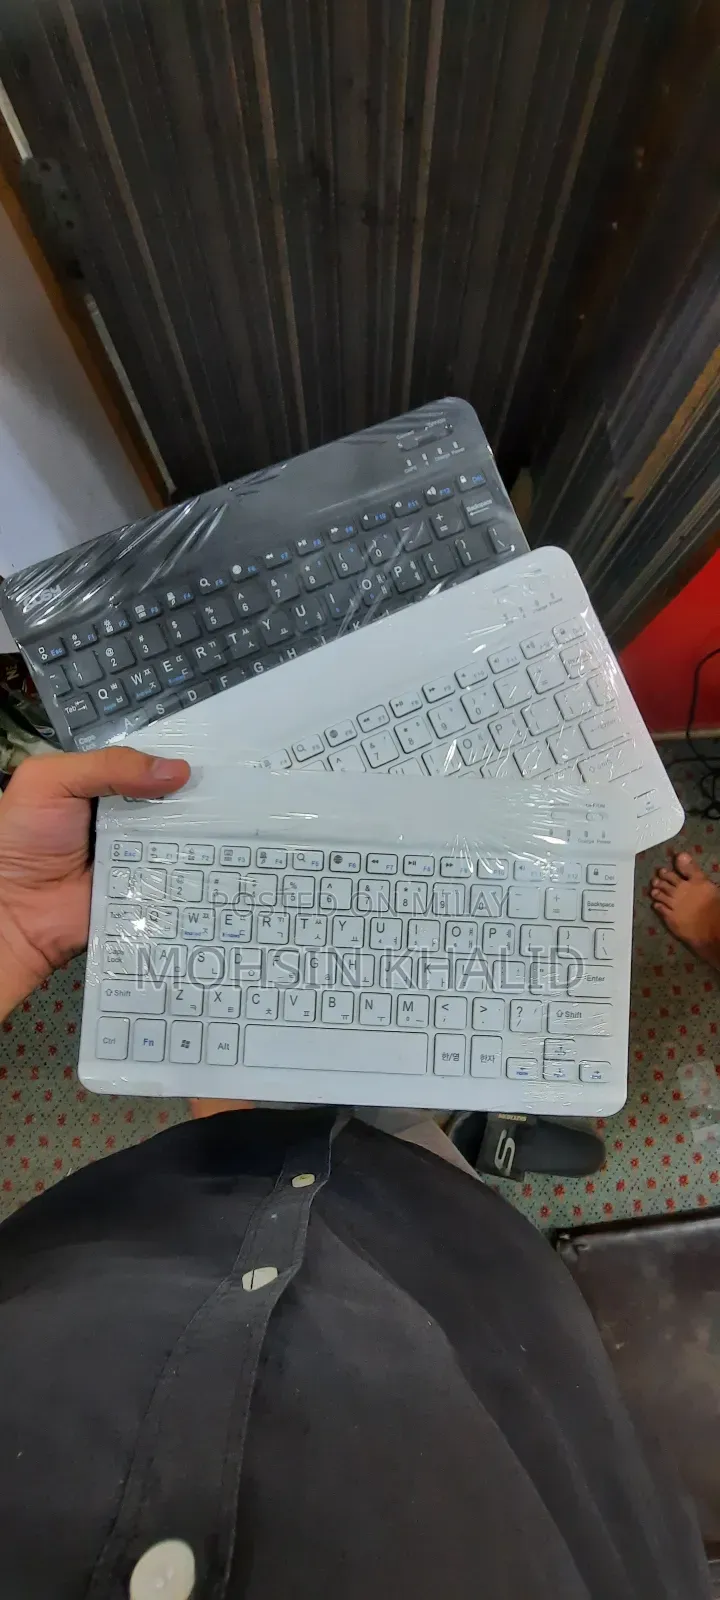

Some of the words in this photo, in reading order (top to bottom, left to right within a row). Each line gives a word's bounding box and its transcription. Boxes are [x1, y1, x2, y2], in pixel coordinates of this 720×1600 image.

[394, 566, 402, 577] P
[362, 579, 372, 590] O
[296, 605, 305, 617] U
[262, 619, 271, 630] Y
[229, 633, 236, 643] T
[196, 647, 207, 658] R
[287, 648, 297, 660] H
[163, 661, 173, 672] E
[254, 661, 264, 673] G
[131, 673, 142, 685] W
[220, 676, 228, 687] F
[98, 689, 108, 699] Q
[187, 690, 197, 700] D
[156, 704, 164, 714] S
[495, 724, 502, 735] P
[463, 739, 472, 749] O
[587, 901, 615, 909] Backspace
[188, 913, 199, 923] W
[225, 915, 233, 925] E
[263, 917, 271, 927] R
[301, 919, 309, 929] T
[339, 921, 346, 931] Y
[377, 922, 384, 933] U
[452, 926, 461, 937] O
[489, 928, 497, 938] P
[160, 950, 168, 960] A
[198, 952, 205, 962] S
[235, 953, 242, 964] D
[310, 958, 318, 968] G
[349, 960, 356, 970] H
[424, 963, 431, 974] K
[176, 990, 183, 1000] Z
[214, 992, 221, 1002] X
[252, 994, 260, 1004] C
[290, 995, 298, 1006] V
[329, 997, 336, 1007] B
[365, 999, 373, 1009] N
[402, 1001, 413, 1011] M
[442, 1052, 460, 1062] 한/영
[480, 1054, 495, 1063] 한자
